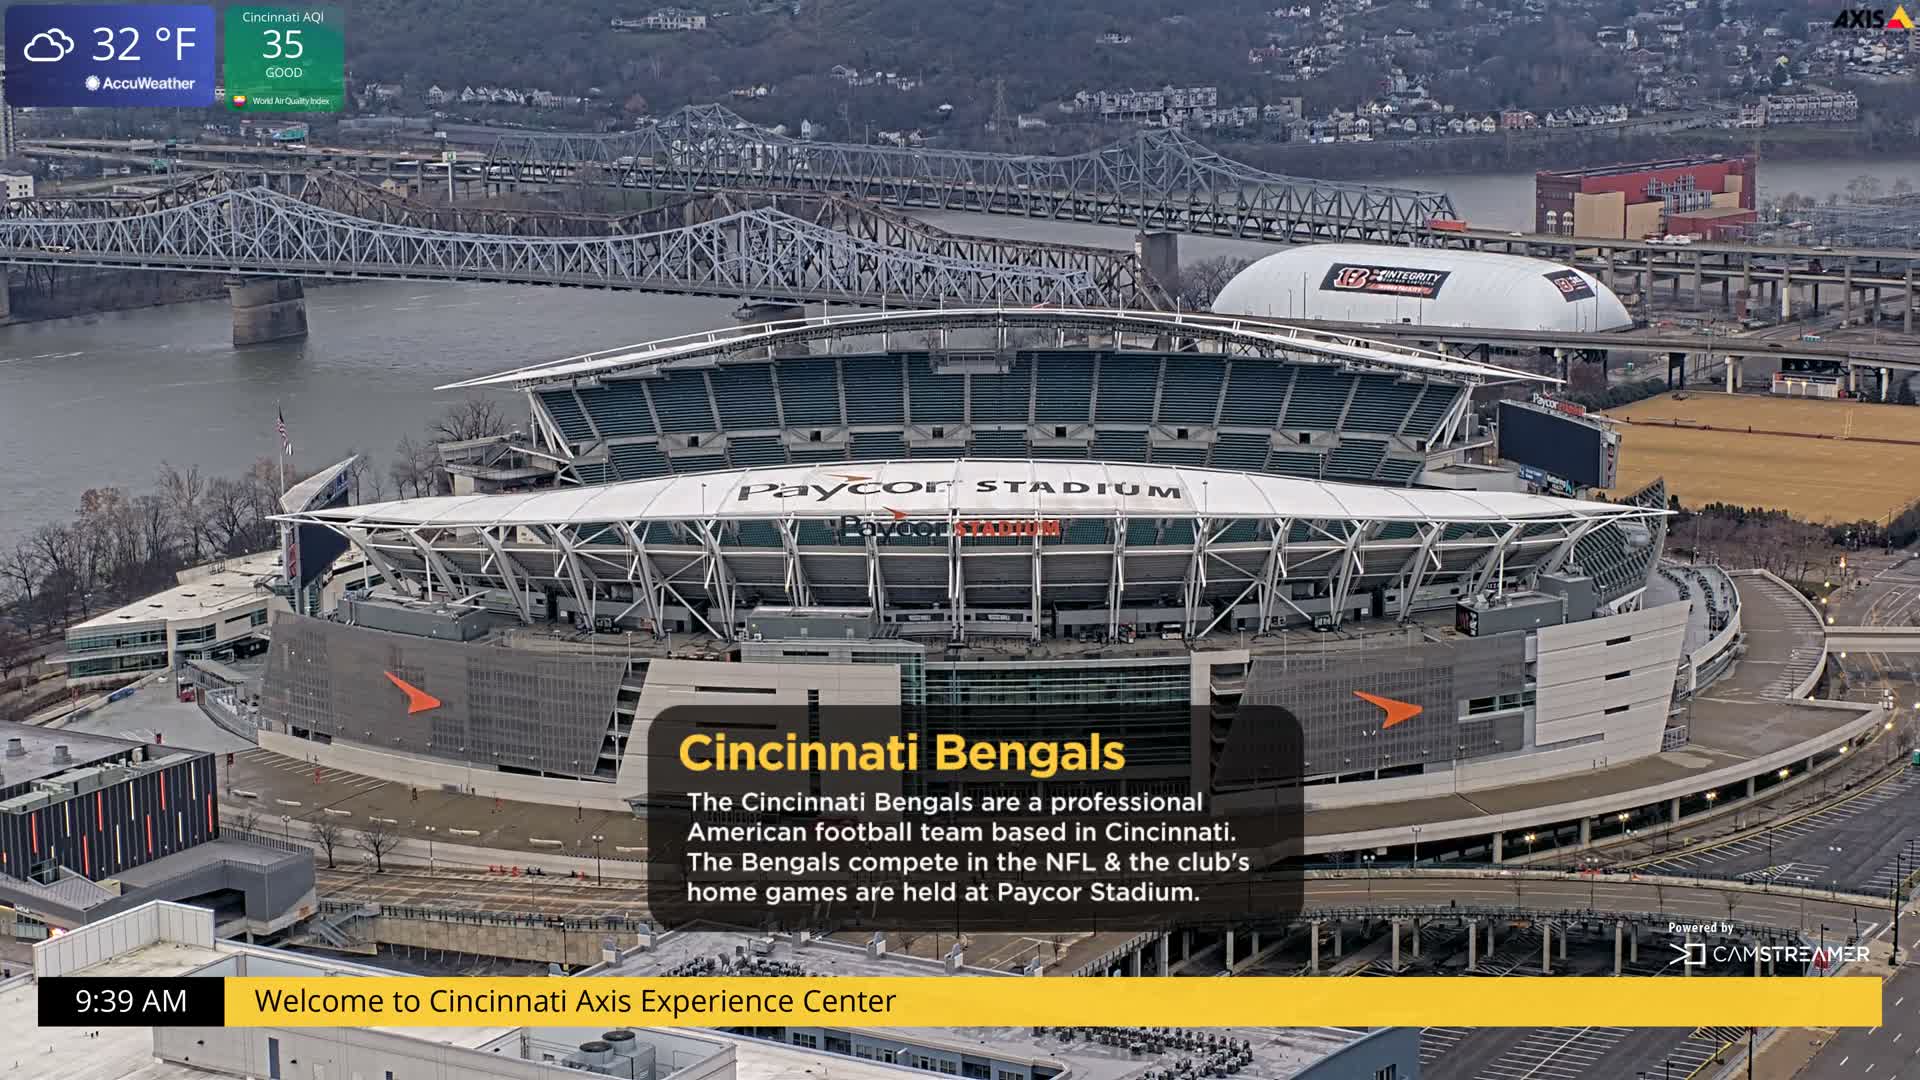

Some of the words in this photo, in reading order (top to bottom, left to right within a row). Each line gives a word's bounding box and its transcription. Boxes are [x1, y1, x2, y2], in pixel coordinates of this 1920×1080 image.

[1384, 269, 1442, 283] INTEGRITY
[737, 480, 957, 502] Paycor
[976, 480, 1182, 499] STADIUM
[840, 514, 955, 545] Paycor
[955, 519, 1061, 538] STADIUM
